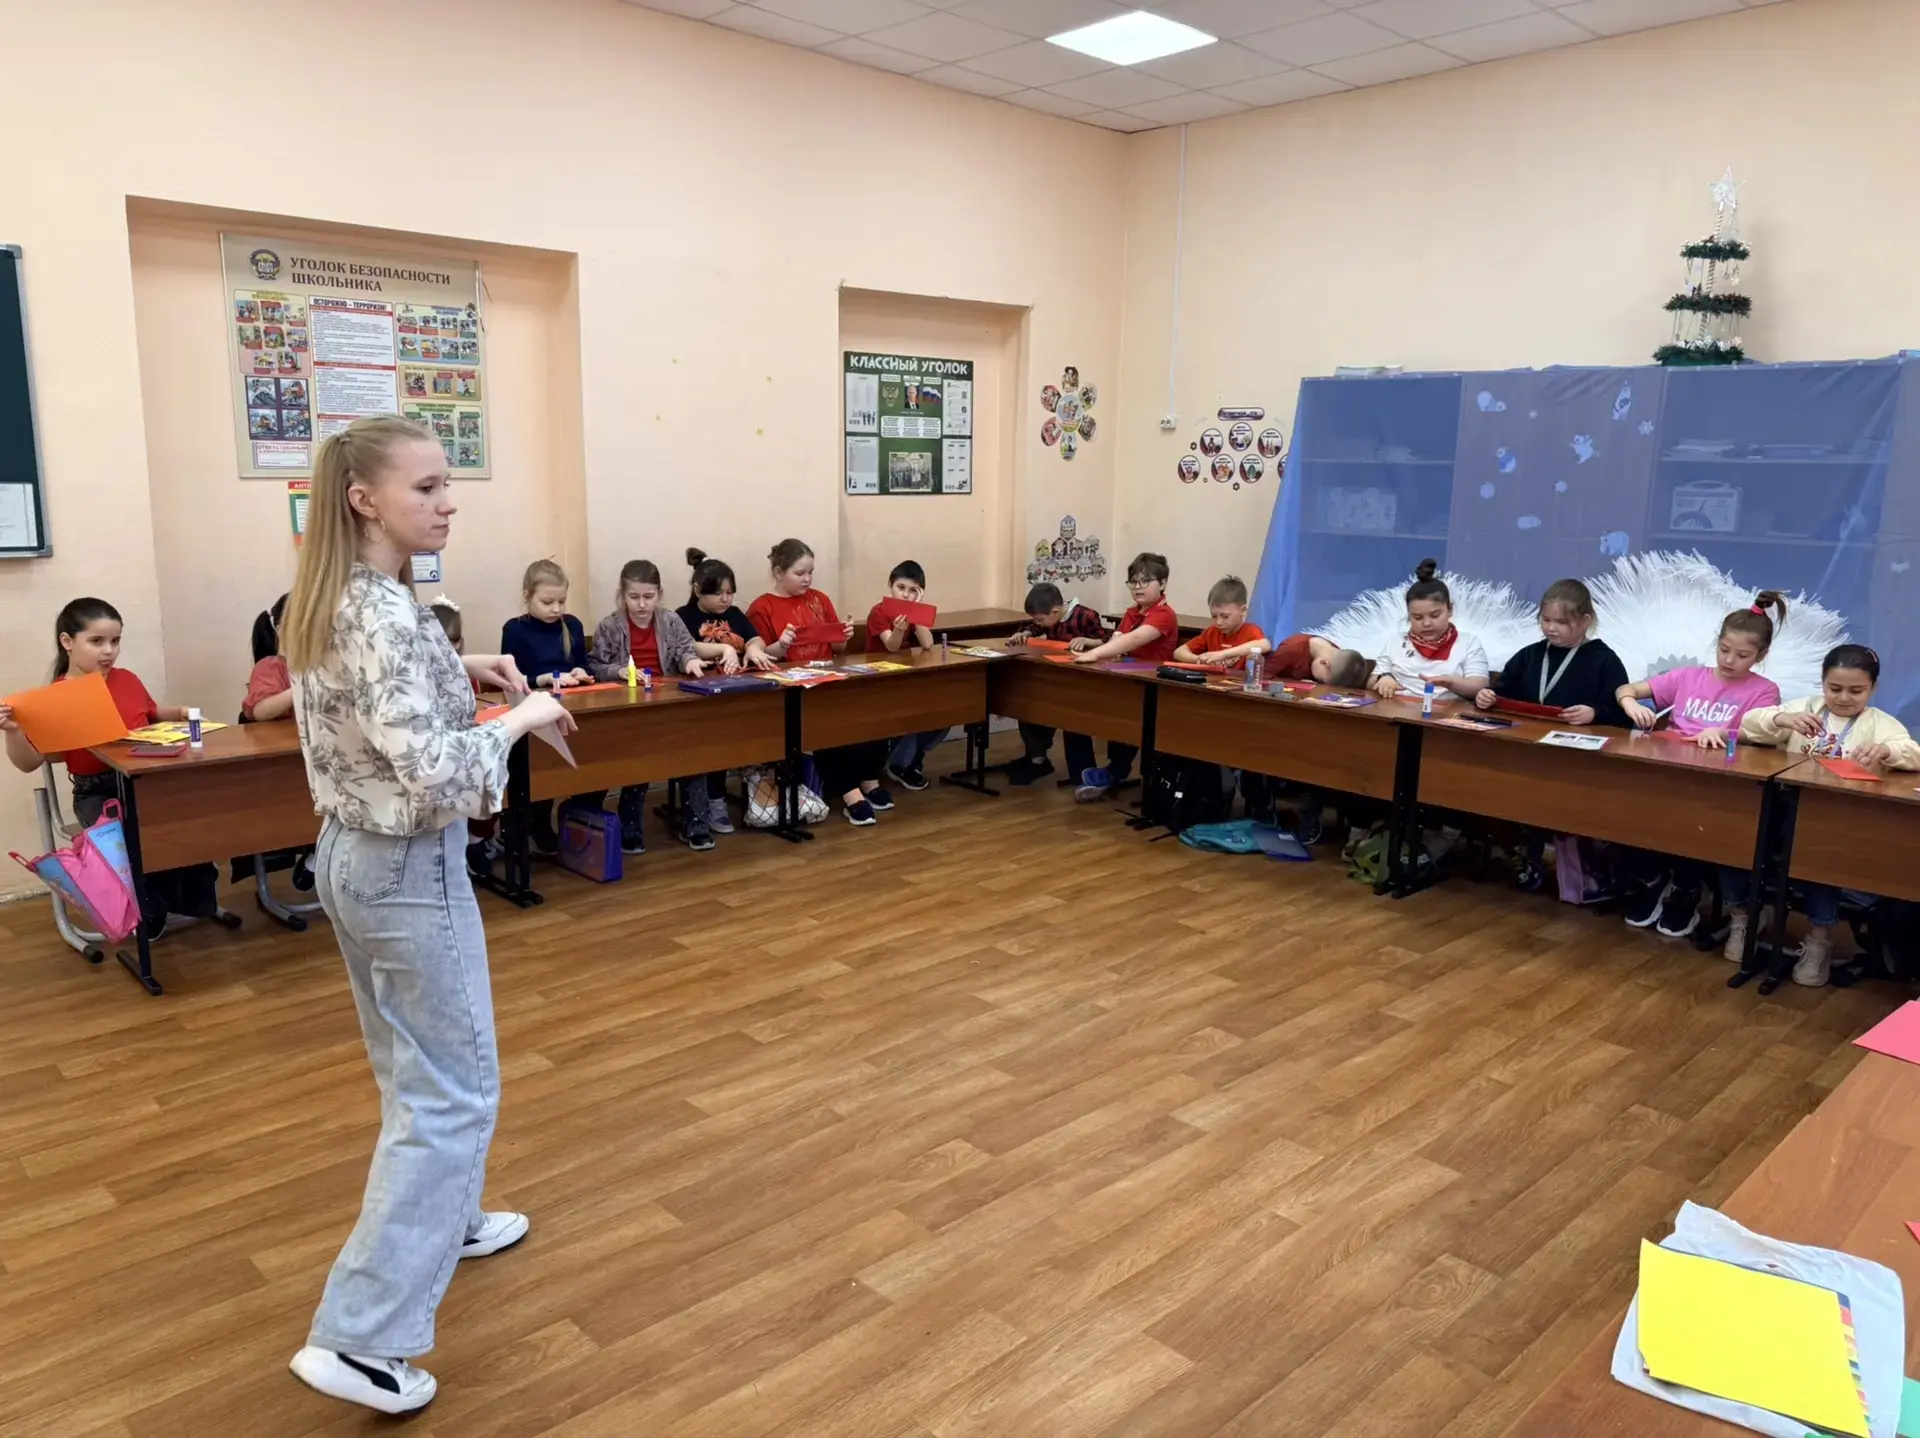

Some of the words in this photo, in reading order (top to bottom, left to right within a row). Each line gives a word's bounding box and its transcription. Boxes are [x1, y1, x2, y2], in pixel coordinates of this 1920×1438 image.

[290, 257, 345, 275] УГОЛОК
[349, 263, 451, 285] БЕЗОПАСНОСТИ
[292, 273, 382, 292] ШКОЛЬНИКА
[850, 355, 918, 372] КЛАССНЫЙ
[921, 361, 968, 375] УГОЛОК
[1682, 697, 1738, 722] MAGIC
